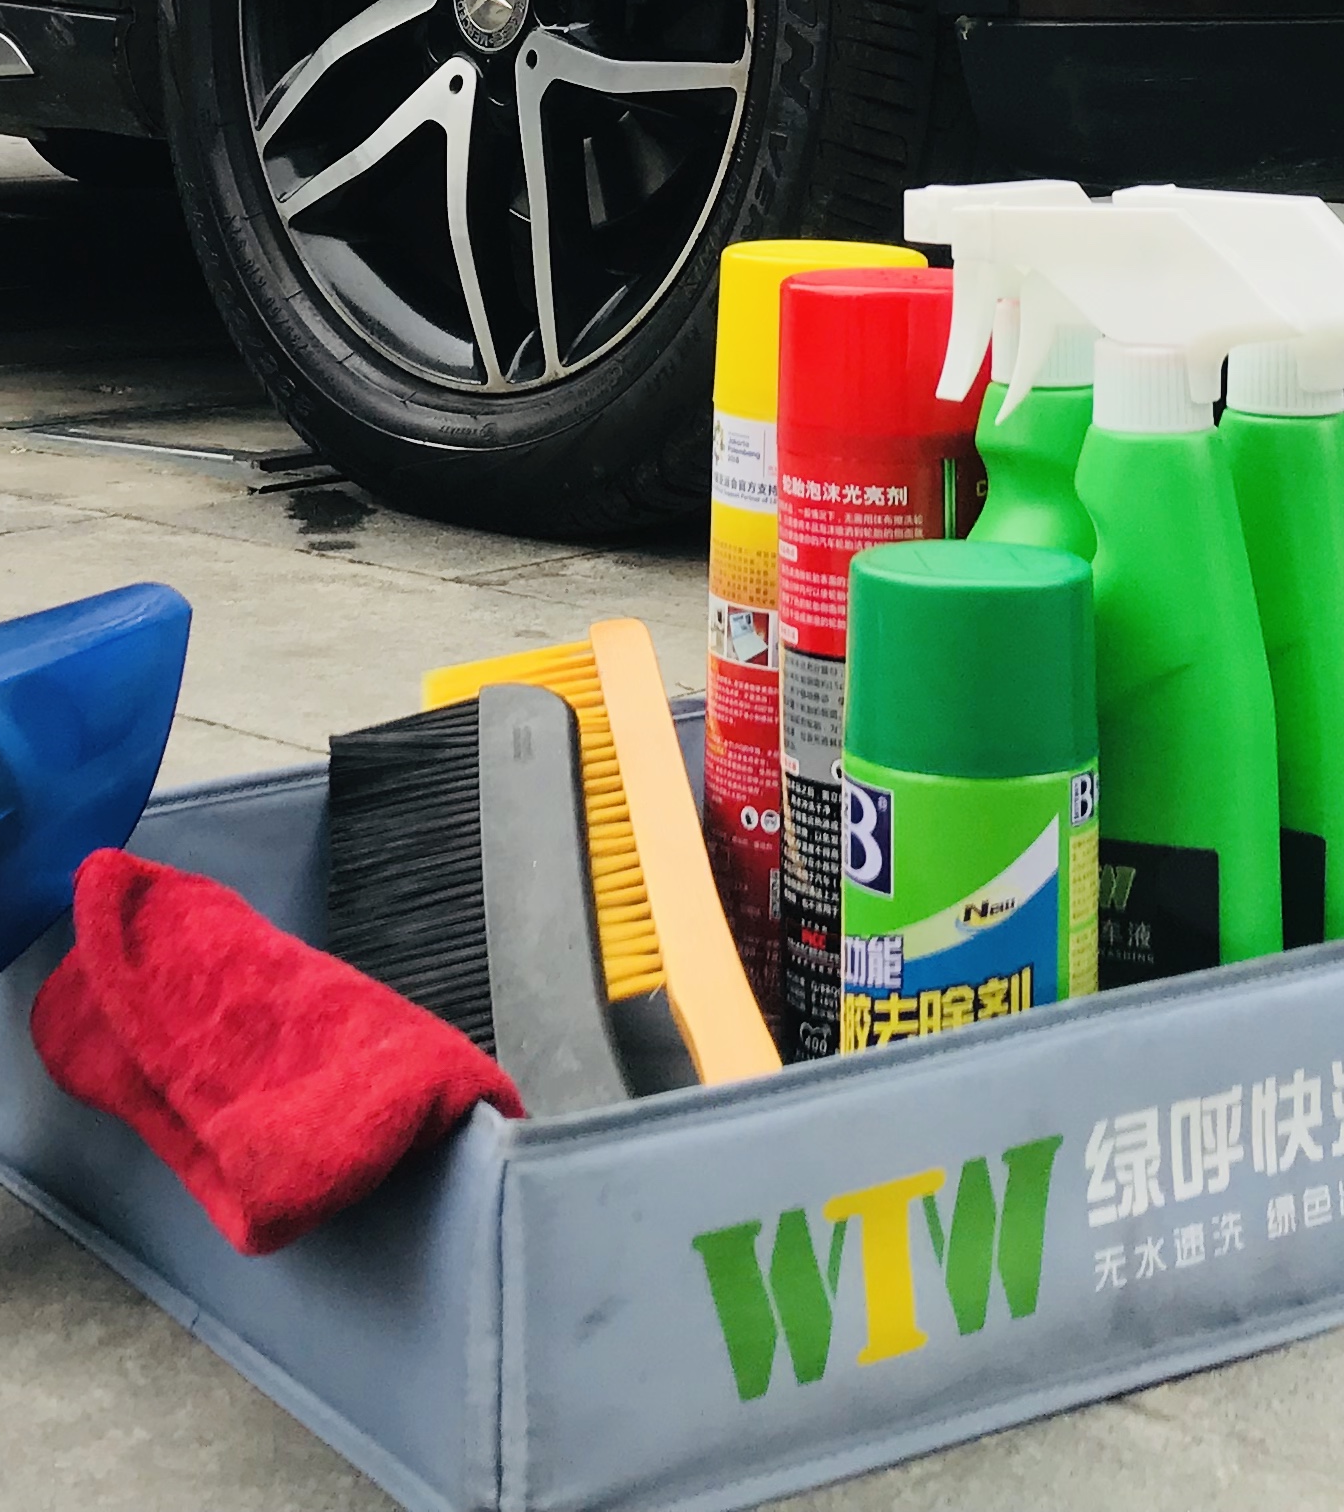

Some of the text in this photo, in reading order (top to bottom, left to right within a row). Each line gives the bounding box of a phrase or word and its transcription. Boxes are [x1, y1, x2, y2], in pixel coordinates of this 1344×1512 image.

[782, 474, 908, 507] 轮胎泡沫光亮剂
[692, 1135, 1064, 1403] WTW
[1094, 1210, 1245, 1292] 无水速洗
